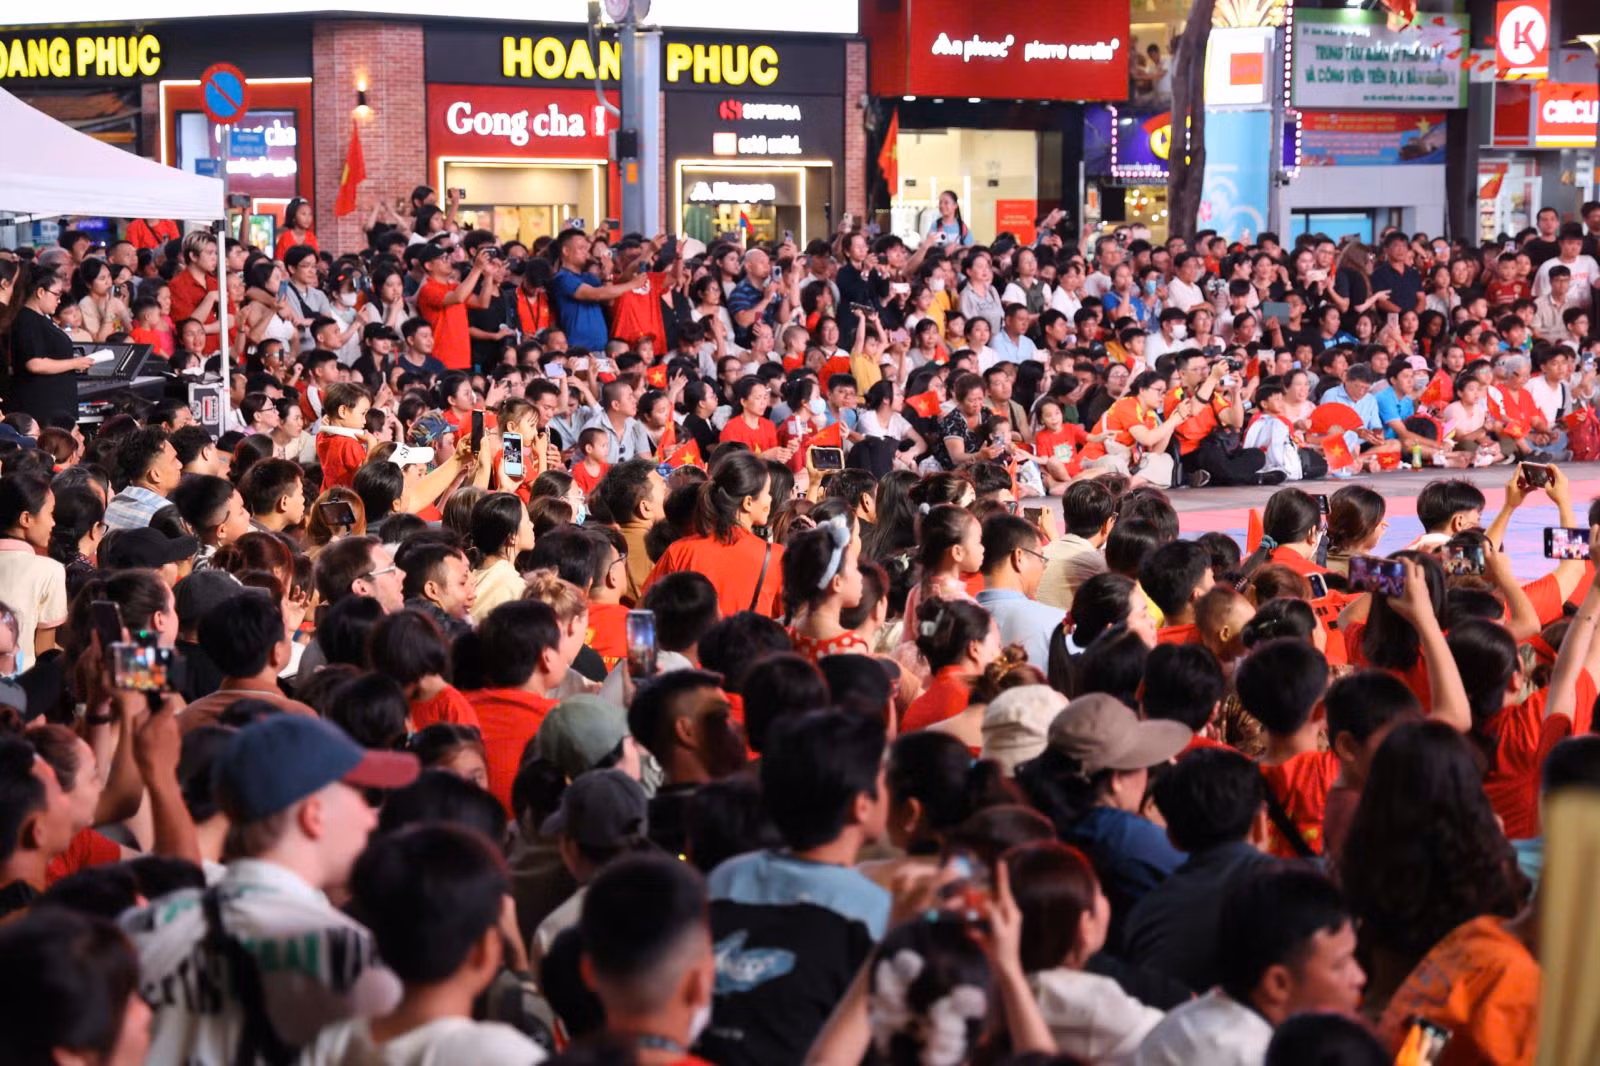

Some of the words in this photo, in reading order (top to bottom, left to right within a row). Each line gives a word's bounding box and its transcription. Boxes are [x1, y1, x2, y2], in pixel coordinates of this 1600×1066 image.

[76, 34, 161, 77] PHUC
[666, 42, 779, 86] PHUC
[446, 101, 529, 146] Gong
[533, 103, 586, 137] cha
